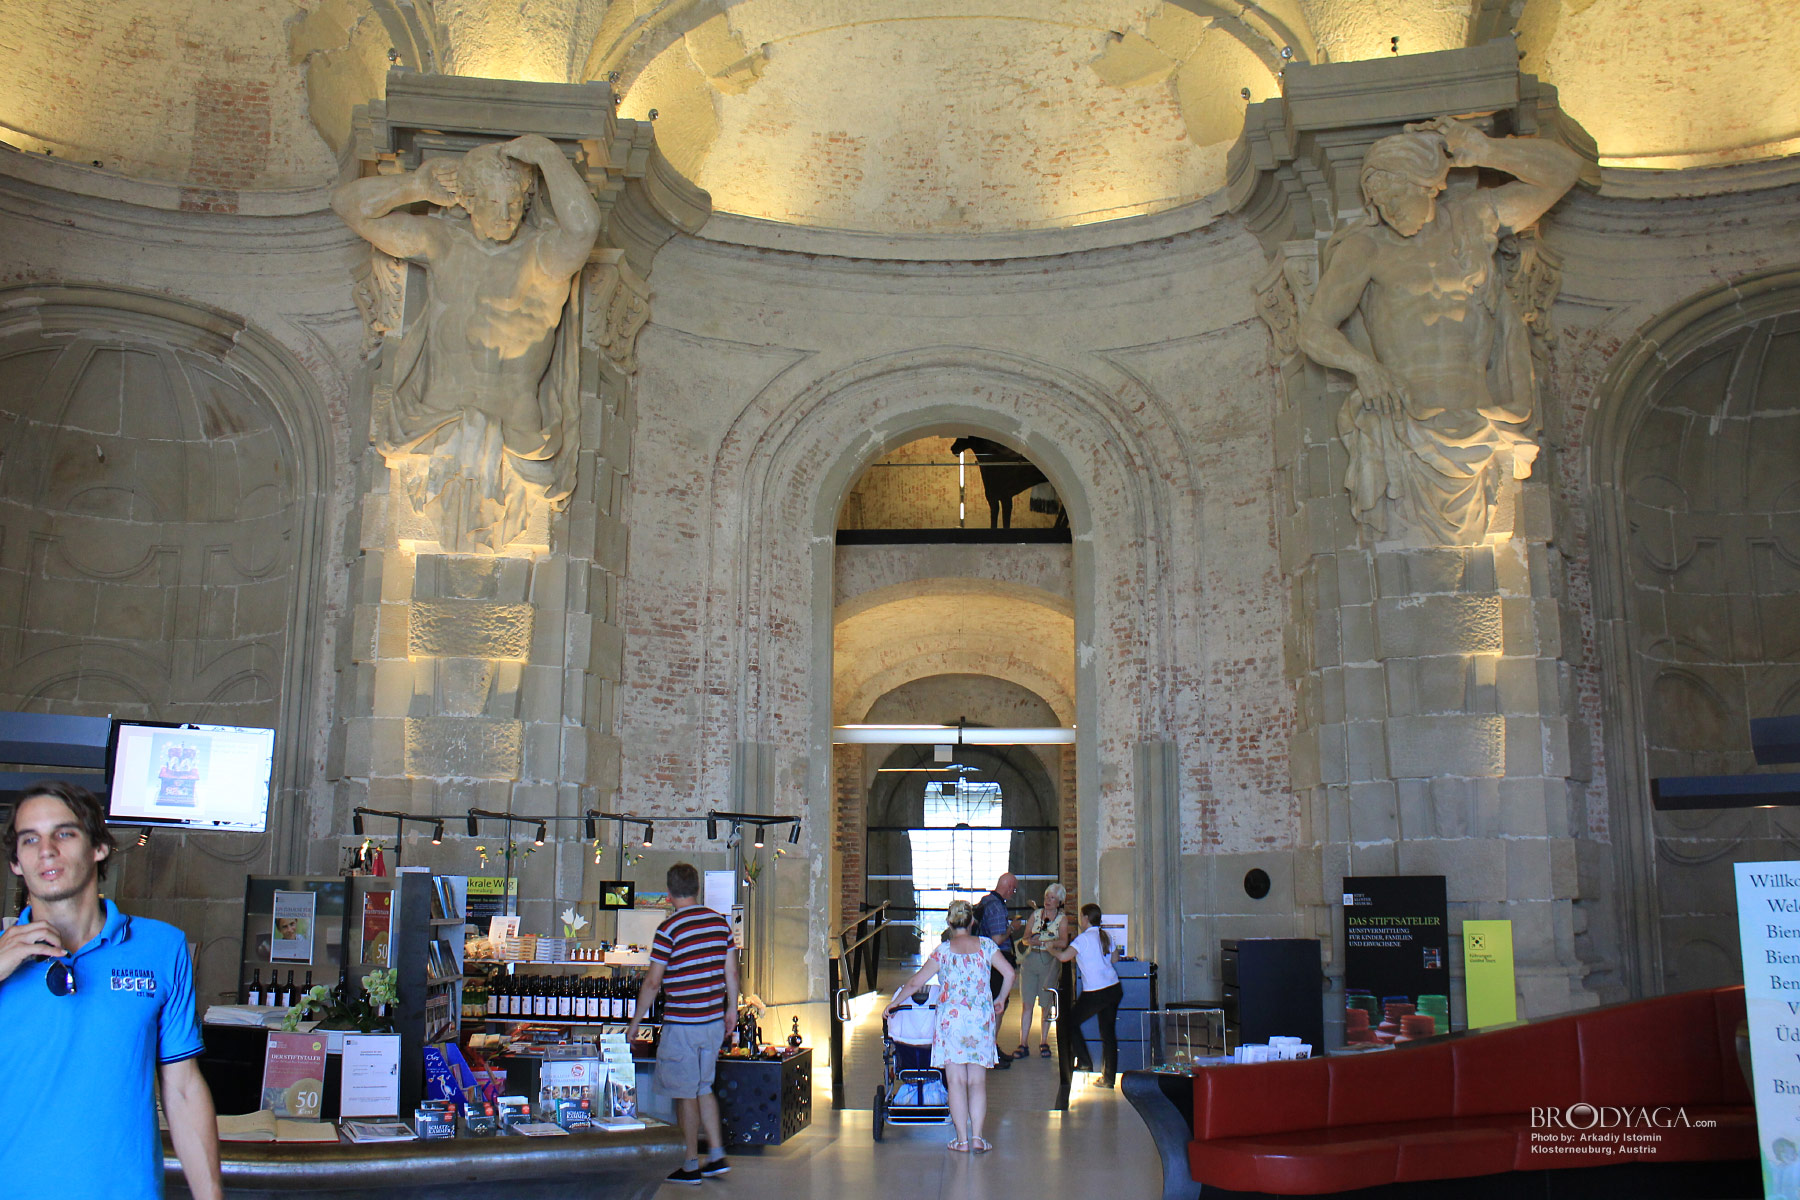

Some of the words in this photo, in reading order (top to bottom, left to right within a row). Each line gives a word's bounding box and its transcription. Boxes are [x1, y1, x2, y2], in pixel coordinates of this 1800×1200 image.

[493, 880, 514, 890] Wg
[1766, 898, 1800, 912] Wel
[1349, 917, 1367, 926] DAS
[1370, 917, 1440, 926] STIFTSATELIER
[1766, 924, 1800, 938] Bien
[376, 944, 388, 960] 50
[1766, 950, 1800, 964] Bien
[111, 976, 157, 992] BSFD
[1770, 975, 1800, 990] Ben
[296, 1091, 318, 1108] 50
